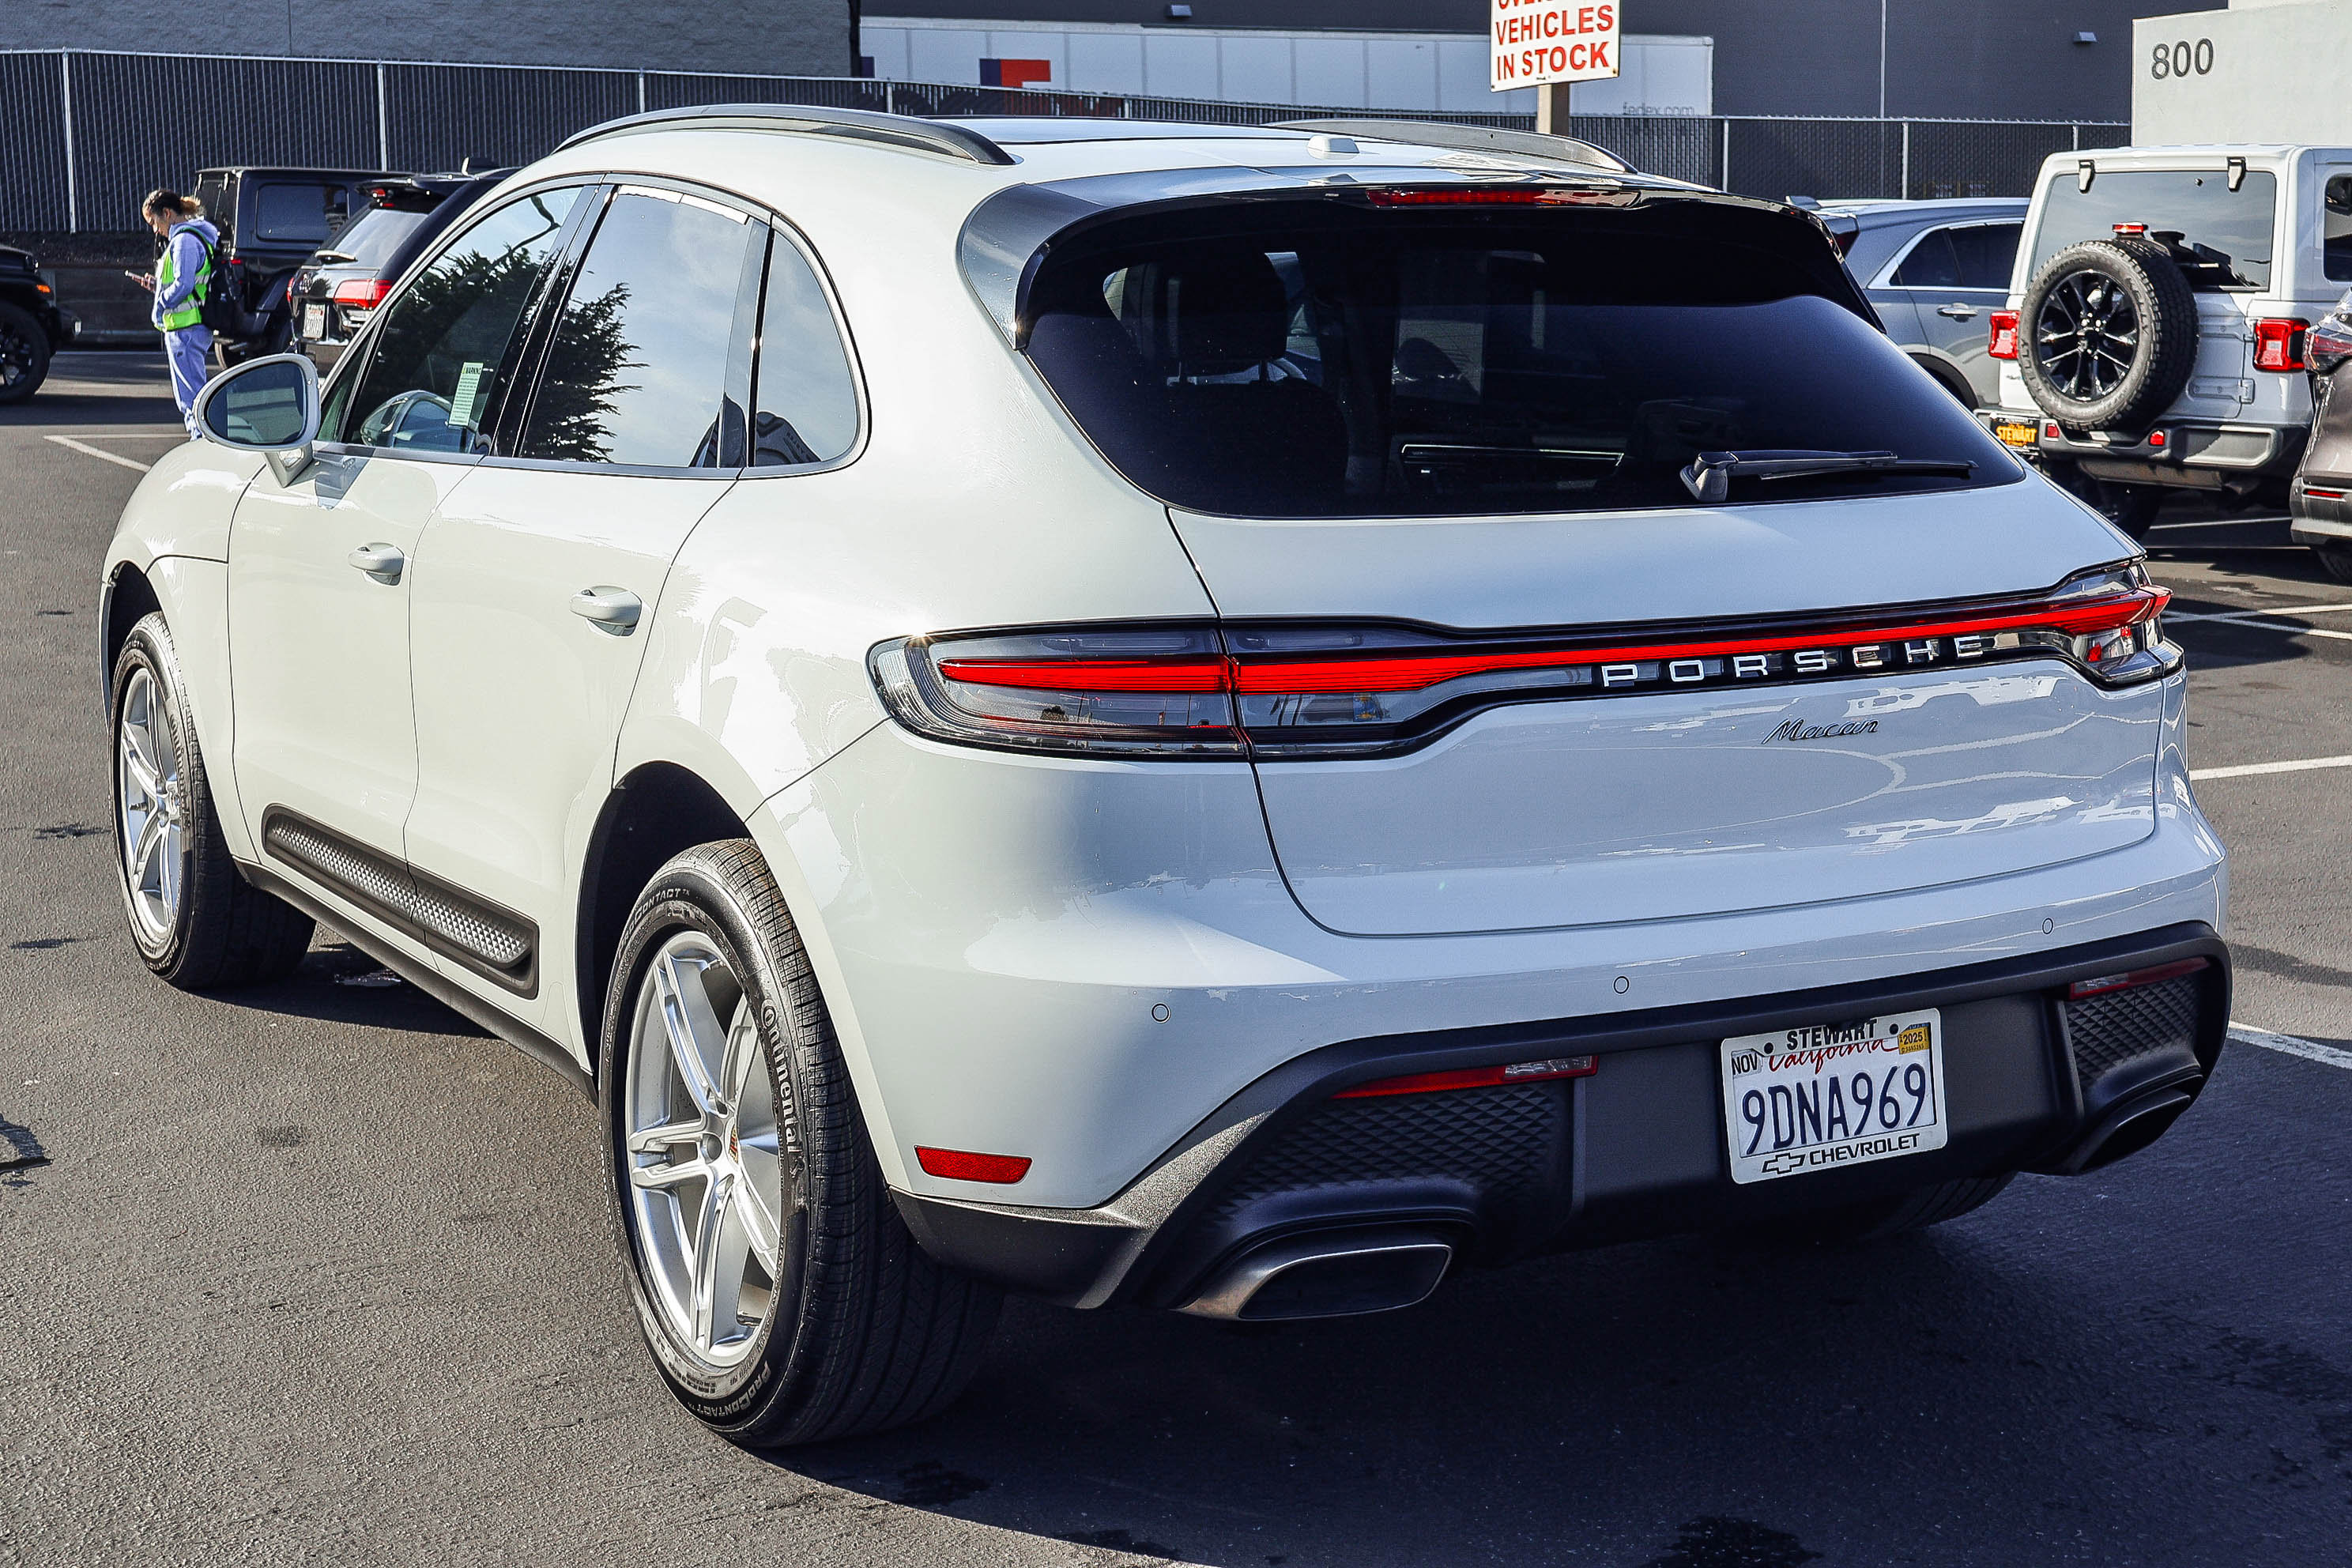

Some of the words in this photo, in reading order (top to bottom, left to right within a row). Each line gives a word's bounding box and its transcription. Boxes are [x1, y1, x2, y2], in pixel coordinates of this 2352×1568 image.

[1496, 5, 1613, 45] VEHICLES
[1498, 54, 1514, 80] IN
[1521, 41, 1609, 76] STOCK
[2151, 38, 2214, 79] 800
[1601, 635, 1983, 687] PORSCHE
[1761, 717, 1879, 744] Macan
[1787, 1019, 1877, 1050] STEWART
[1903, 1031, 1923, 1045] 2025
[760, 998, 803, 1153] Continental
[1732, 1052, 1758, 1075] NOV
[1743, 1063, 1926, 1155] 9DNA969
[1810, 1133, 1920, 1165] CHEVROLET
